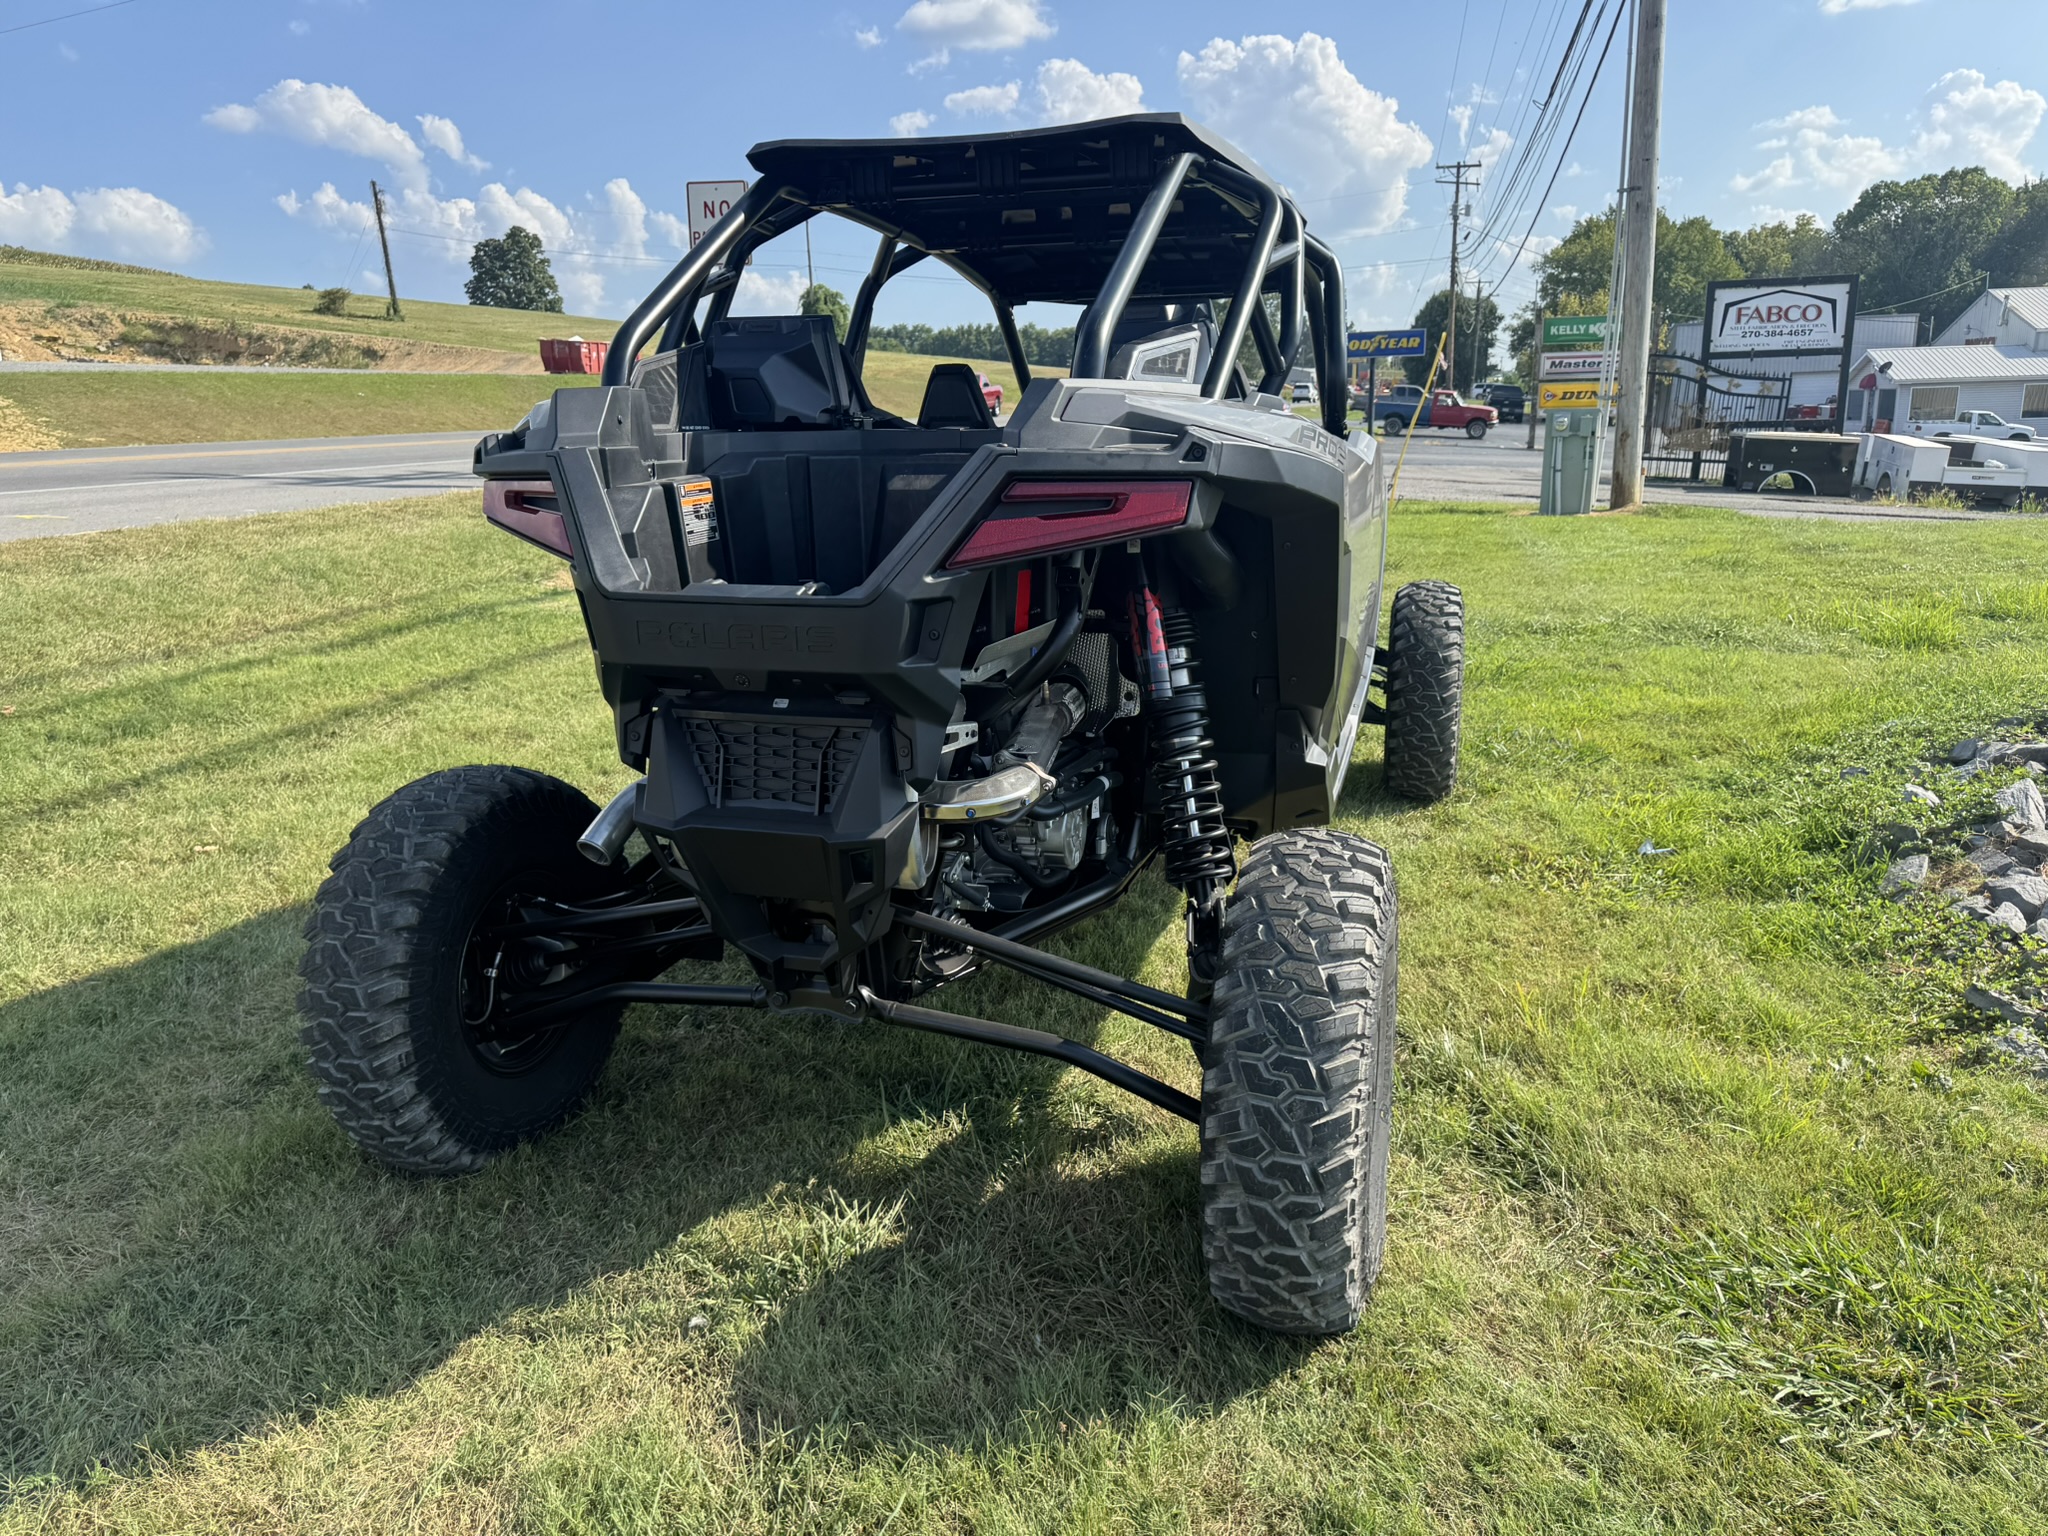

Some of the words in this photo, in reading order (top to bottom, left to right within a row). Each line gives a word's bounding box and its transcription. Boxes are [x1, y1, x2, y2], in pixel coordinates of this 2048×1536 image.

[703, 200, 731, 219] NO
[1735, 304, 1823, 325] FABCO
[1550, 324, 1587, 335] KELLY
[1741, 329, 1814, 338] 270-384-4657
[1349, 335, 1421, 352] ODYEAR
[1550, 360, 1605, 369] Master
[636, 620, 838, 652] POLARIS
